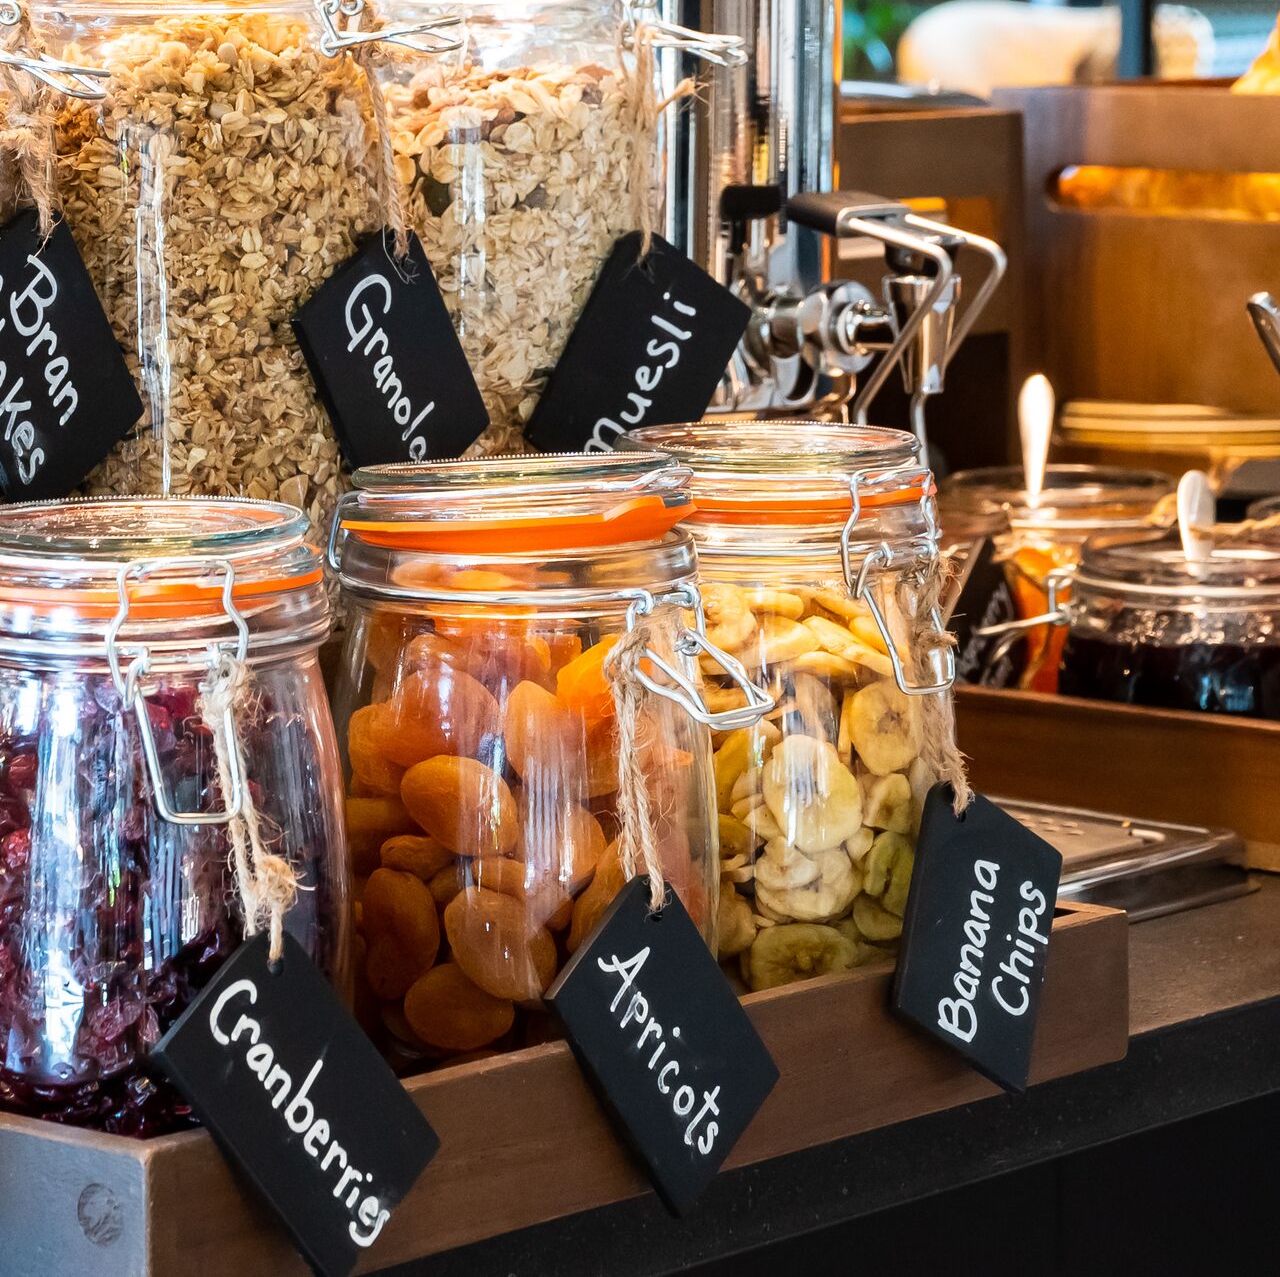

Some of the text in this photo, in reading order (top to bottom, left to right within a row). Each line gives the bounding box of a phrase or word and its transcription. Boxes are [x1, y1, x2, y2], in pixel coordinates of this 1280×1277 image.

[9, 253, 79, 427] Bran
[344, 272, 435, 463] Granola
[937, 859, 1001, 1043] Banana
[991, 880, 1049, 1016] Chips
[209, 978, 391, 1248] Cranberries
[596, 946, 721, 1155] Apricots
